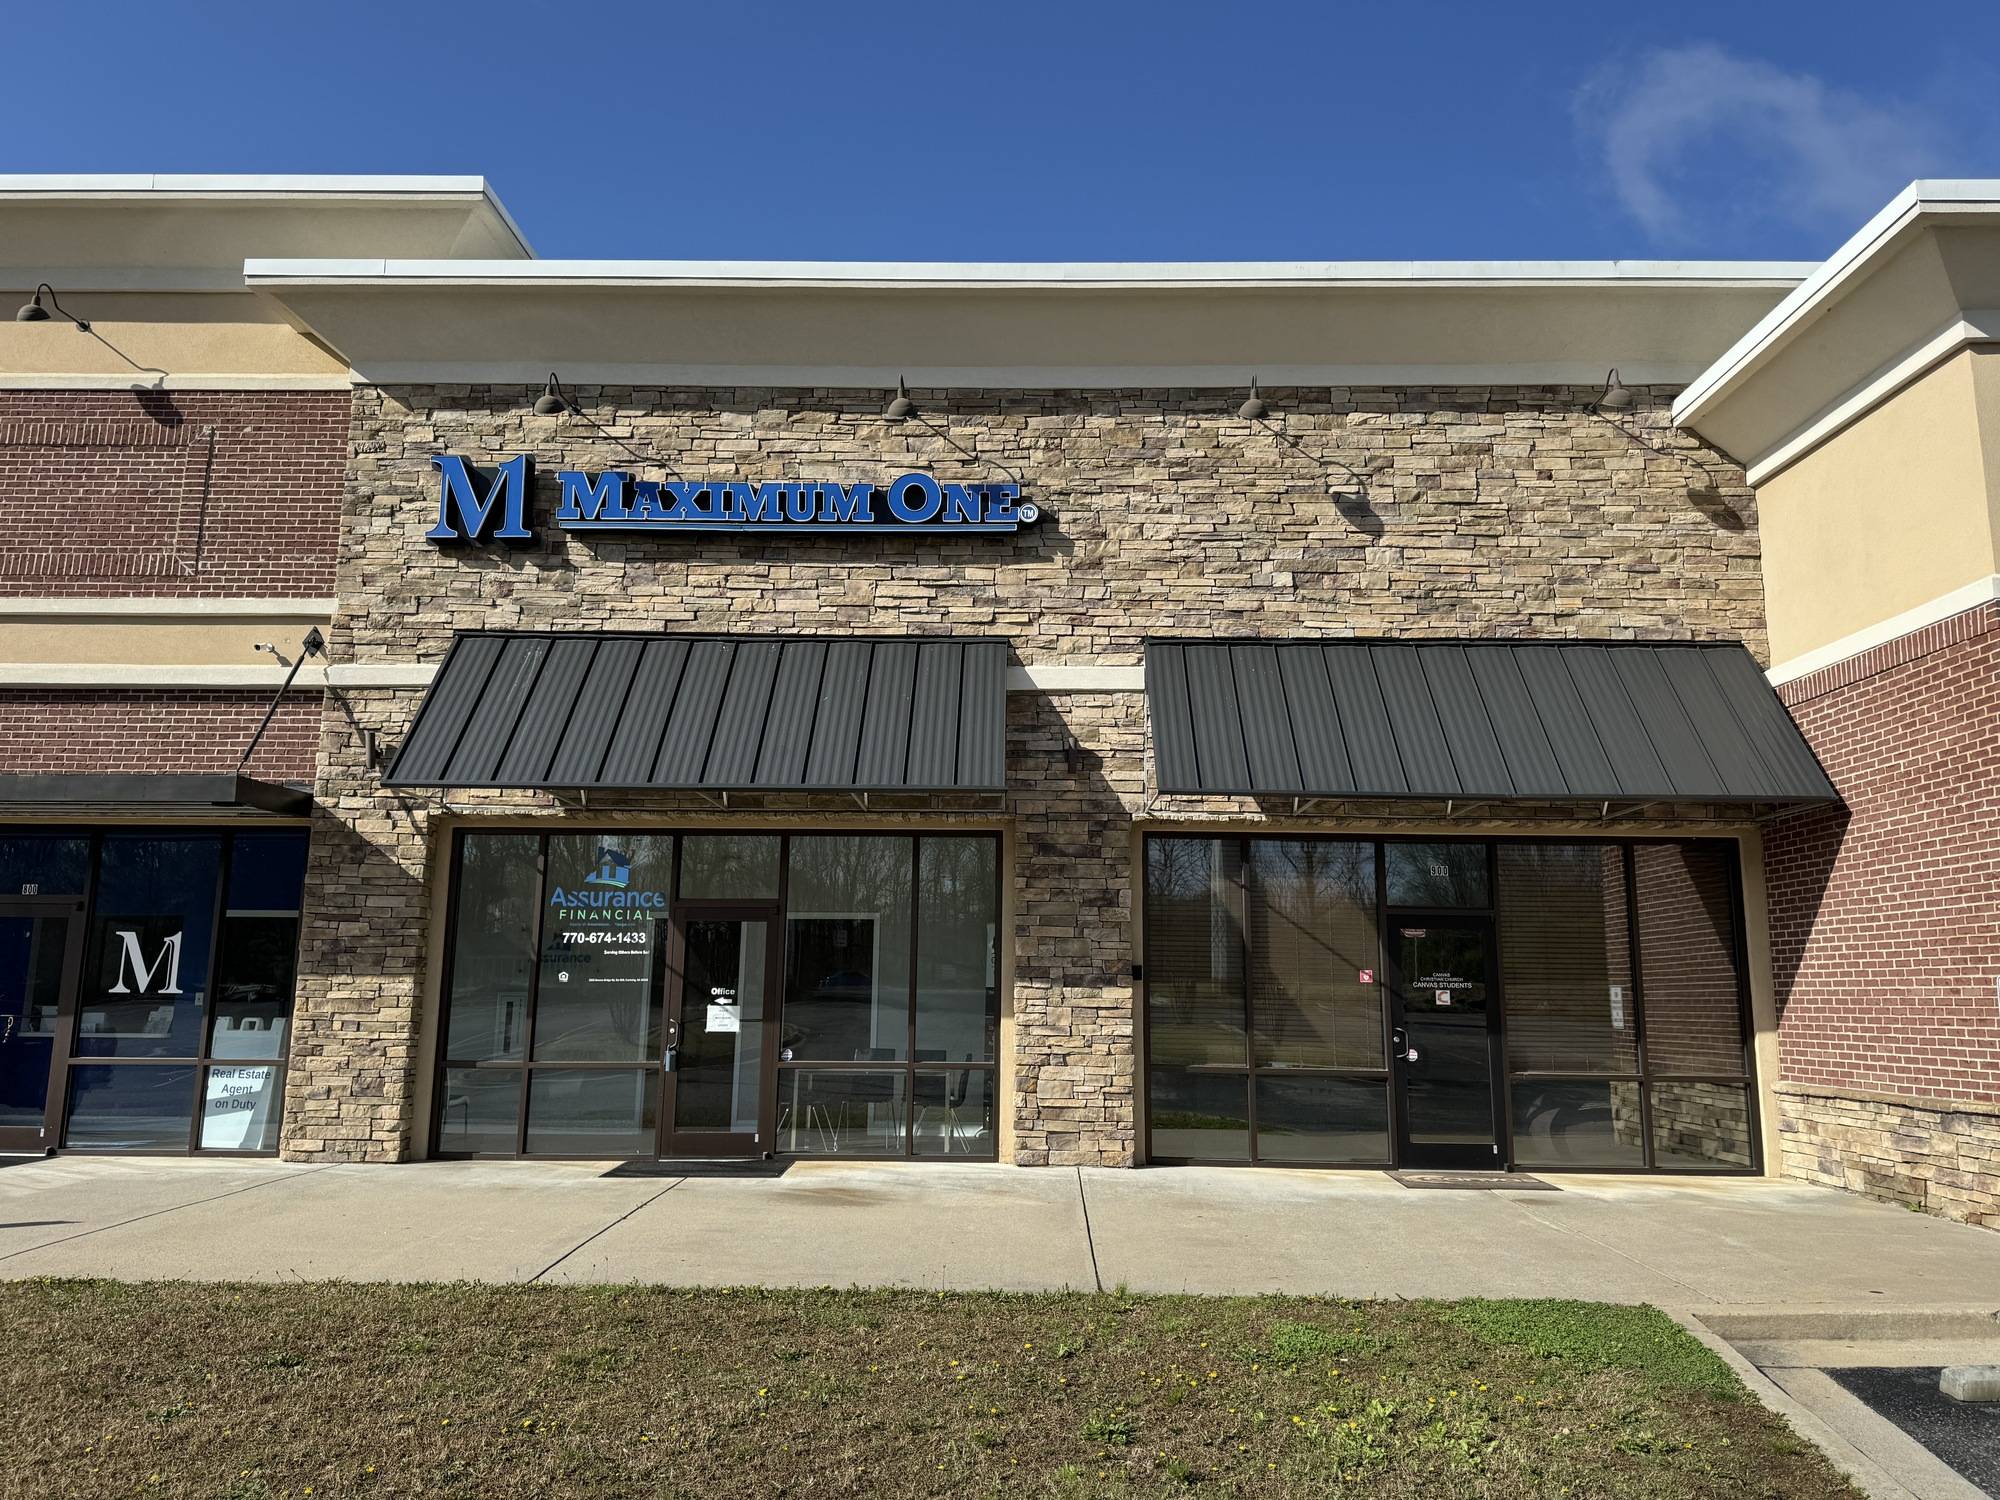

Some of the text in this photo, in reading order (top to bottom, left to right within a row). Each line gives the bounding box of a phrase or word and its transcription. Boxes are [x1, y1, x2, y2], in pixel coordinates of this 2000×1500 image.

[1431, 866, 1448, 875] 900
[550, 886, 665, 907] Assurance
[559, 909, 654, 920] FINANCIAL
[562, 932, 647, 944] 770-674-1433
[711, 987, 735, 995] Office
[211, 1068, 271, 1080] Real Estate
[221, 1083, 253, 1096] Agent
[215, 1099, 257, 1111] on Duty
